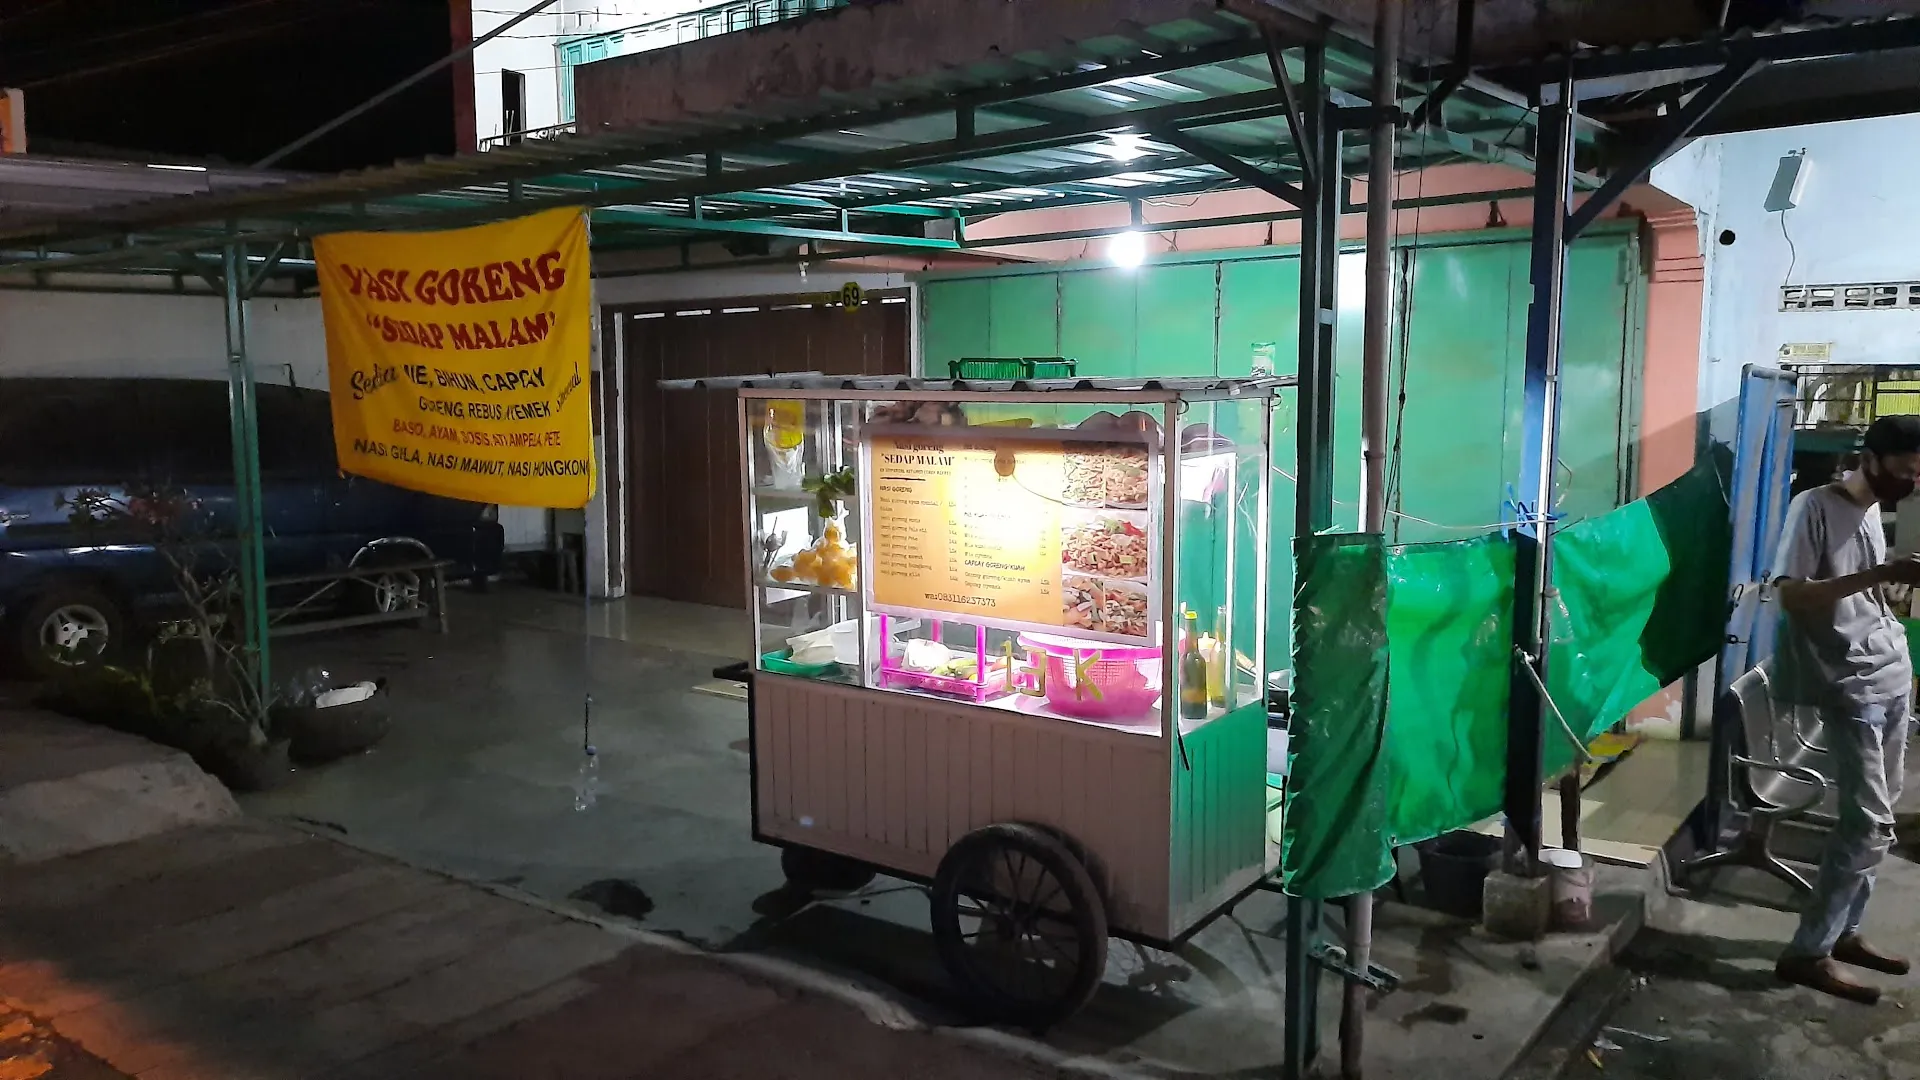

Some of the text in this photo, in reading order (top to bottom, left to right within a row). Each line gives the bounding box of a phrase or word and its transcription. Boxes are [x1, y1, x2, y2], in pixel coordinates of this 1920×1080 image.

[414, 250, 566, 306] GORENG
[843, 287, 859, 306] 69
[427, 451, 458, 470] NASI
[507, 461, 532, 477] NASI
[533, 459, 589, 477] HONGKON
